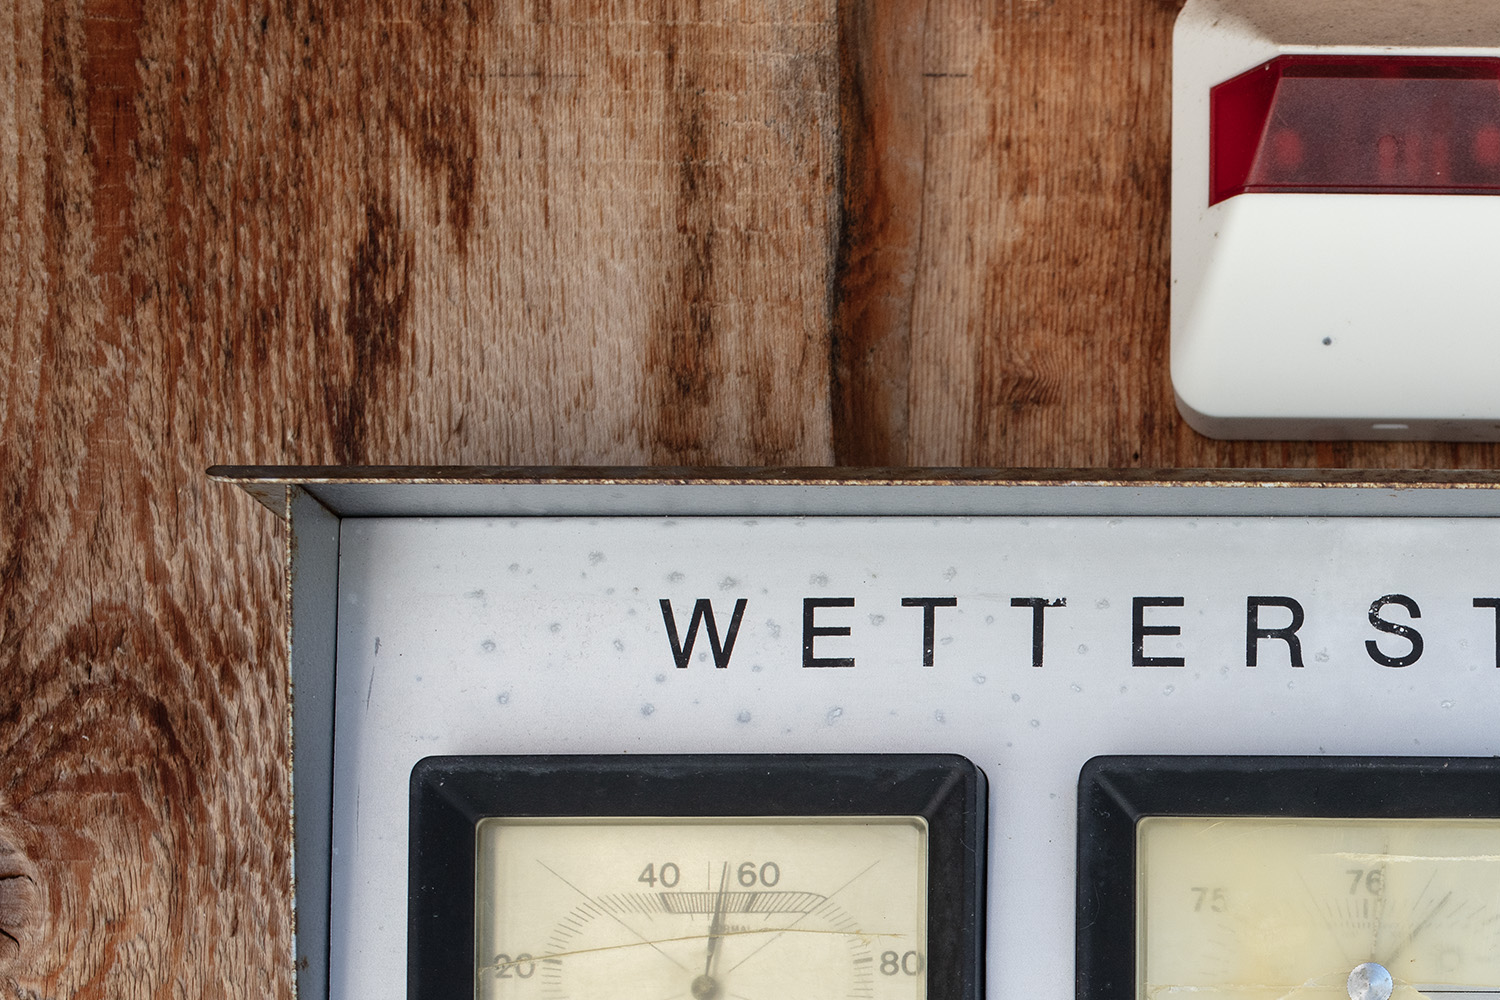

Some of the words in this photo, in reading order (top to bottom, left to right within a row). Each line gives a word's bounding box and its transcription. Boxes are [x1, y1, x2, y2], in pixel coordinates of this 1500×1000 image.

[638, 862, 680, 887] 40
[737, 862, 781, 887] 60
[1345, 869, 1383, 895] 76
[493, 953, 536, 979] 20
[880, 950, 922, 976] 80
